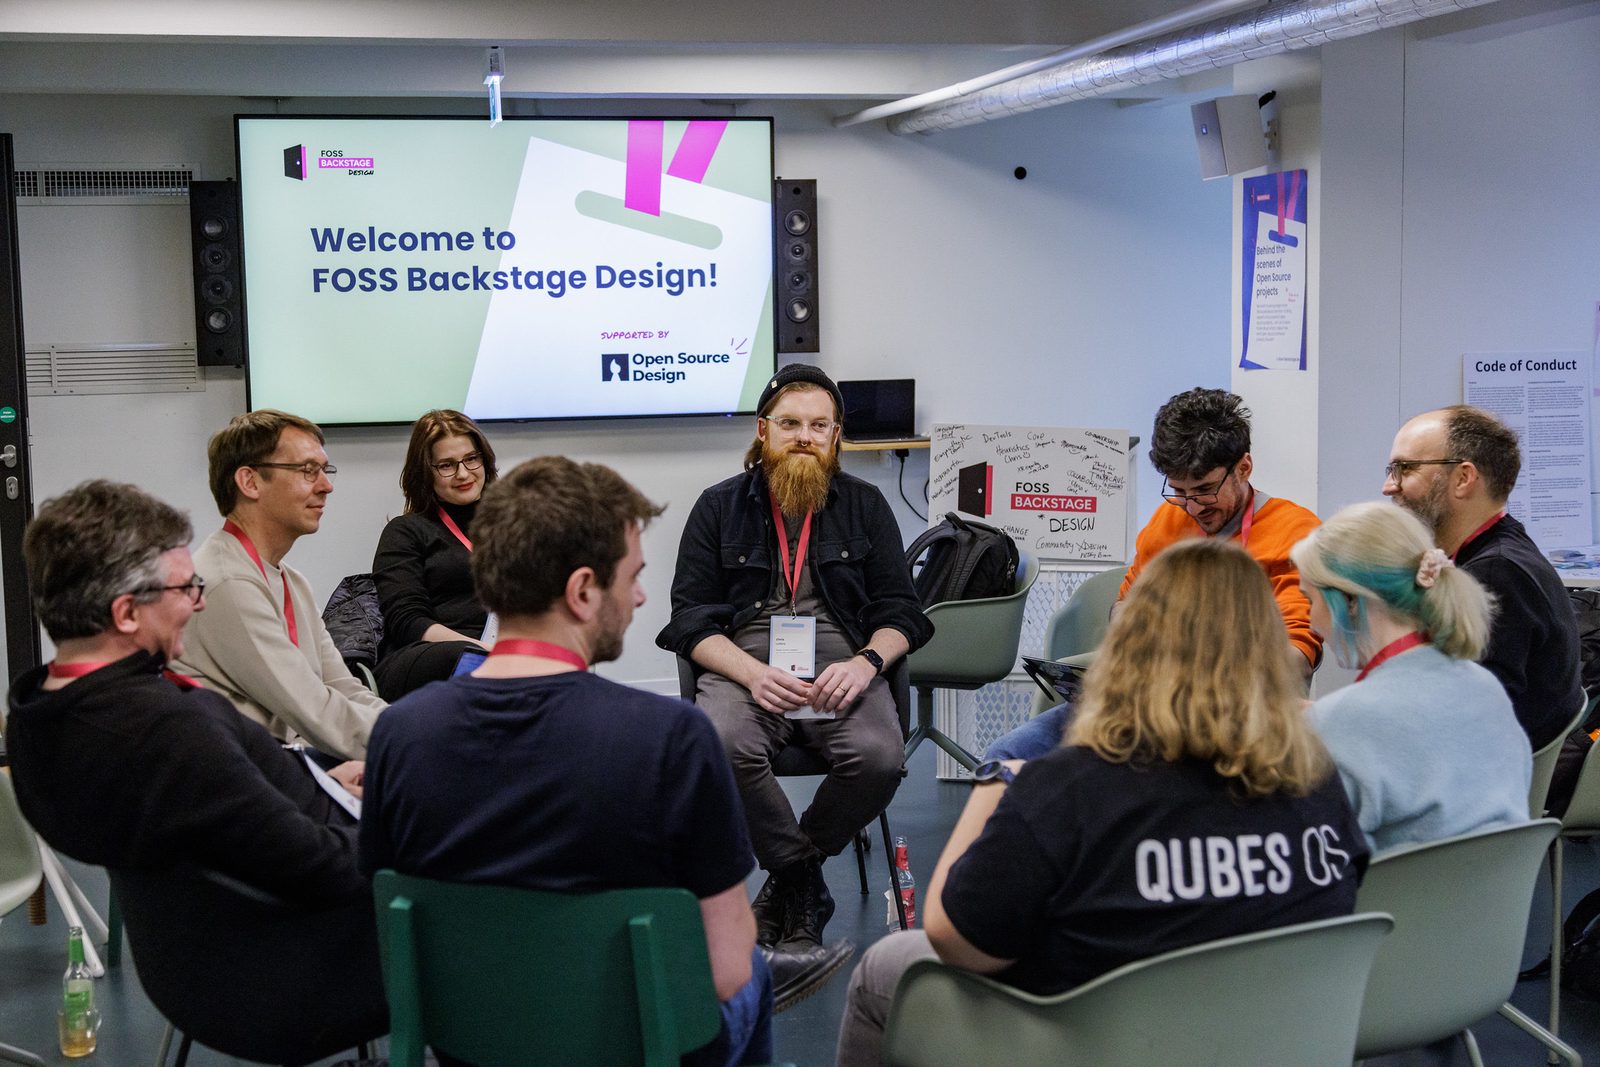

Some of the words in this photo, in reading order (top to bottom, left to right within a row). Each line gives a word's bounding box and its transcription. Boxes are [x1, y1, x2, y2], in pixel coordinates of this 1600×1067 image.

[321, 159, 371, 167] BACKSTAGE
[310, 226, 475, 252] Welcome
[482, 227, 516, 251] to
[1256, 245, 1276, 256] Behind
[1256, 260, 1276, 269] scenes
[313, 267, 398, 293] FOSS
[407, 265, 587, 298] Backstage
[595, 261, 717, 296] Design!
[1256, 273, 1272, 285] Open
[1272, 272, 1292, 282] Source
[1256, 287, 1279, 299] projects
[600, 331, 654, 340] SUPPORTED
[657, 330, 670, 339] BY
[632, 353, 674, 368] Open
[678, 352, 730, 364] Source
[1475, 360, 1506, 373] Code
[1509, 360, 1523, 372] of
[1525, 359, 1577, 371] Conduct
[633, 368, 686, 384] Design
[1016, 482, 1050, 493] FOSS
[1015, 497, 1092, 510] BACKSTAGE
[1049, 518, 1096, 533] DESIGN
[1135, 832, 1291, 903] QUBES
[1302, 824, 1350, 886] OS
